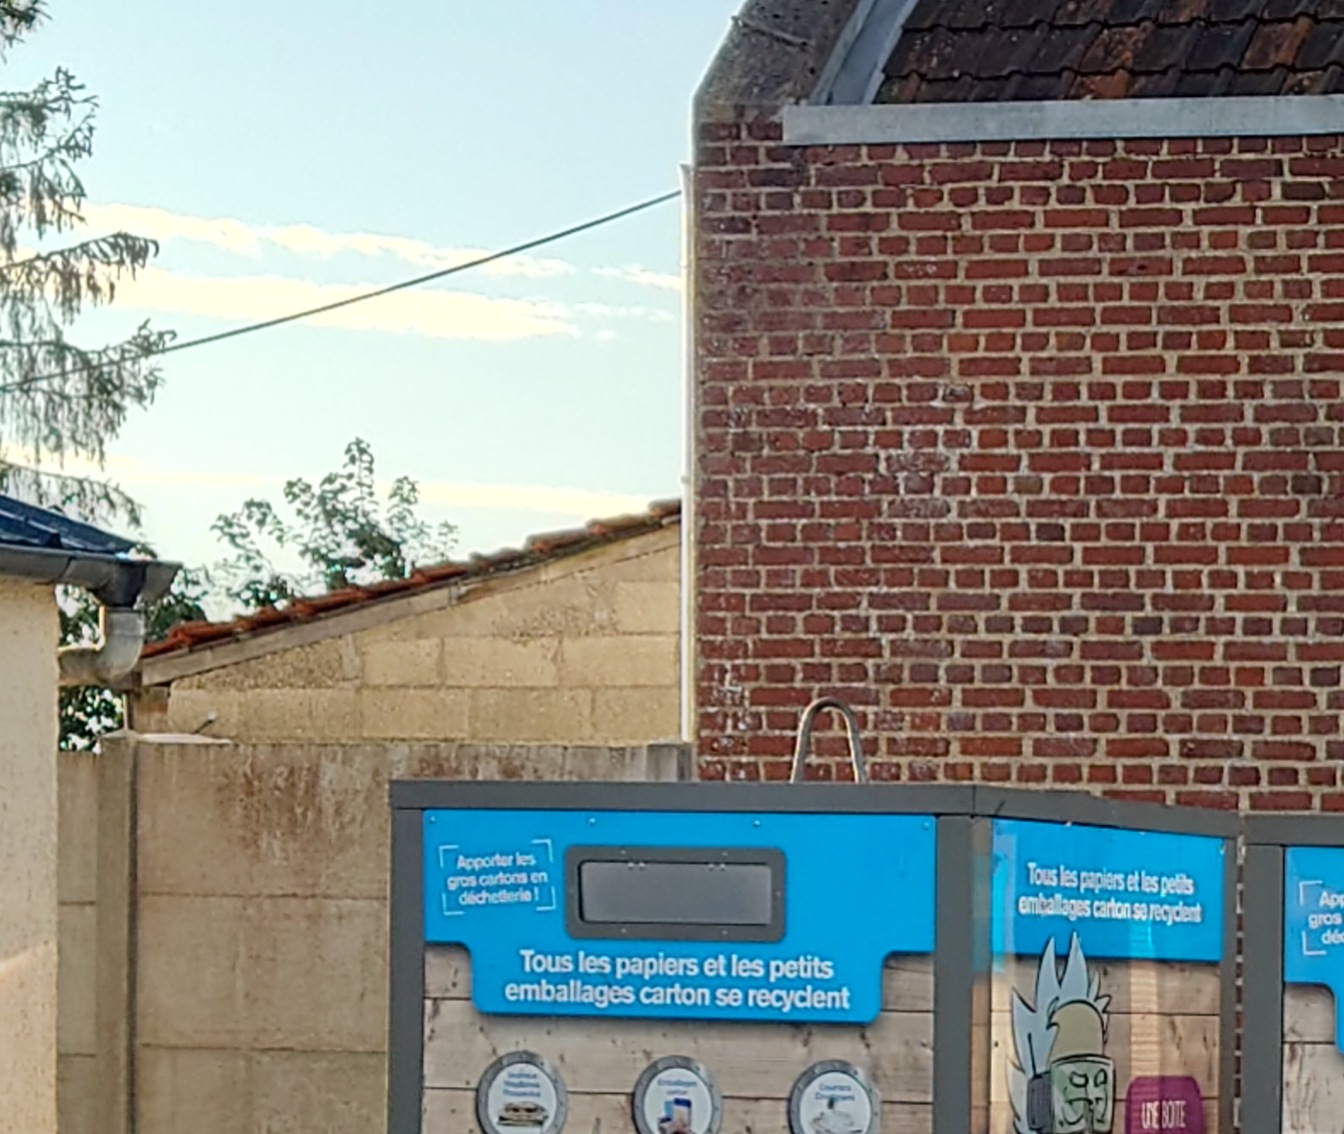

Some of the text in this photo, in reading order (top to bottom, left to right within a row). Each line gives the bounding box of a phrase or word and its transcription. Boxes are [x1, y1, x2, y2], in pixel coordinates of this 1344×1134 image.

[457, 851, 536, 871] Apporter les
[447, 870, 548, 891] gros cartons en
[1027, 861, 1194, 897] Tous les papiers et les petits
[1018, 892, 1202, 926] emballages carton se recyclent
[1308, 912, 1342, 929] gros
[519, 948, 834, 983] Tous les papiers et les petits
[505, 979, 851, 1013] emballages carton se recyclent
[1141, 1101, 1160, 1129] UNE
